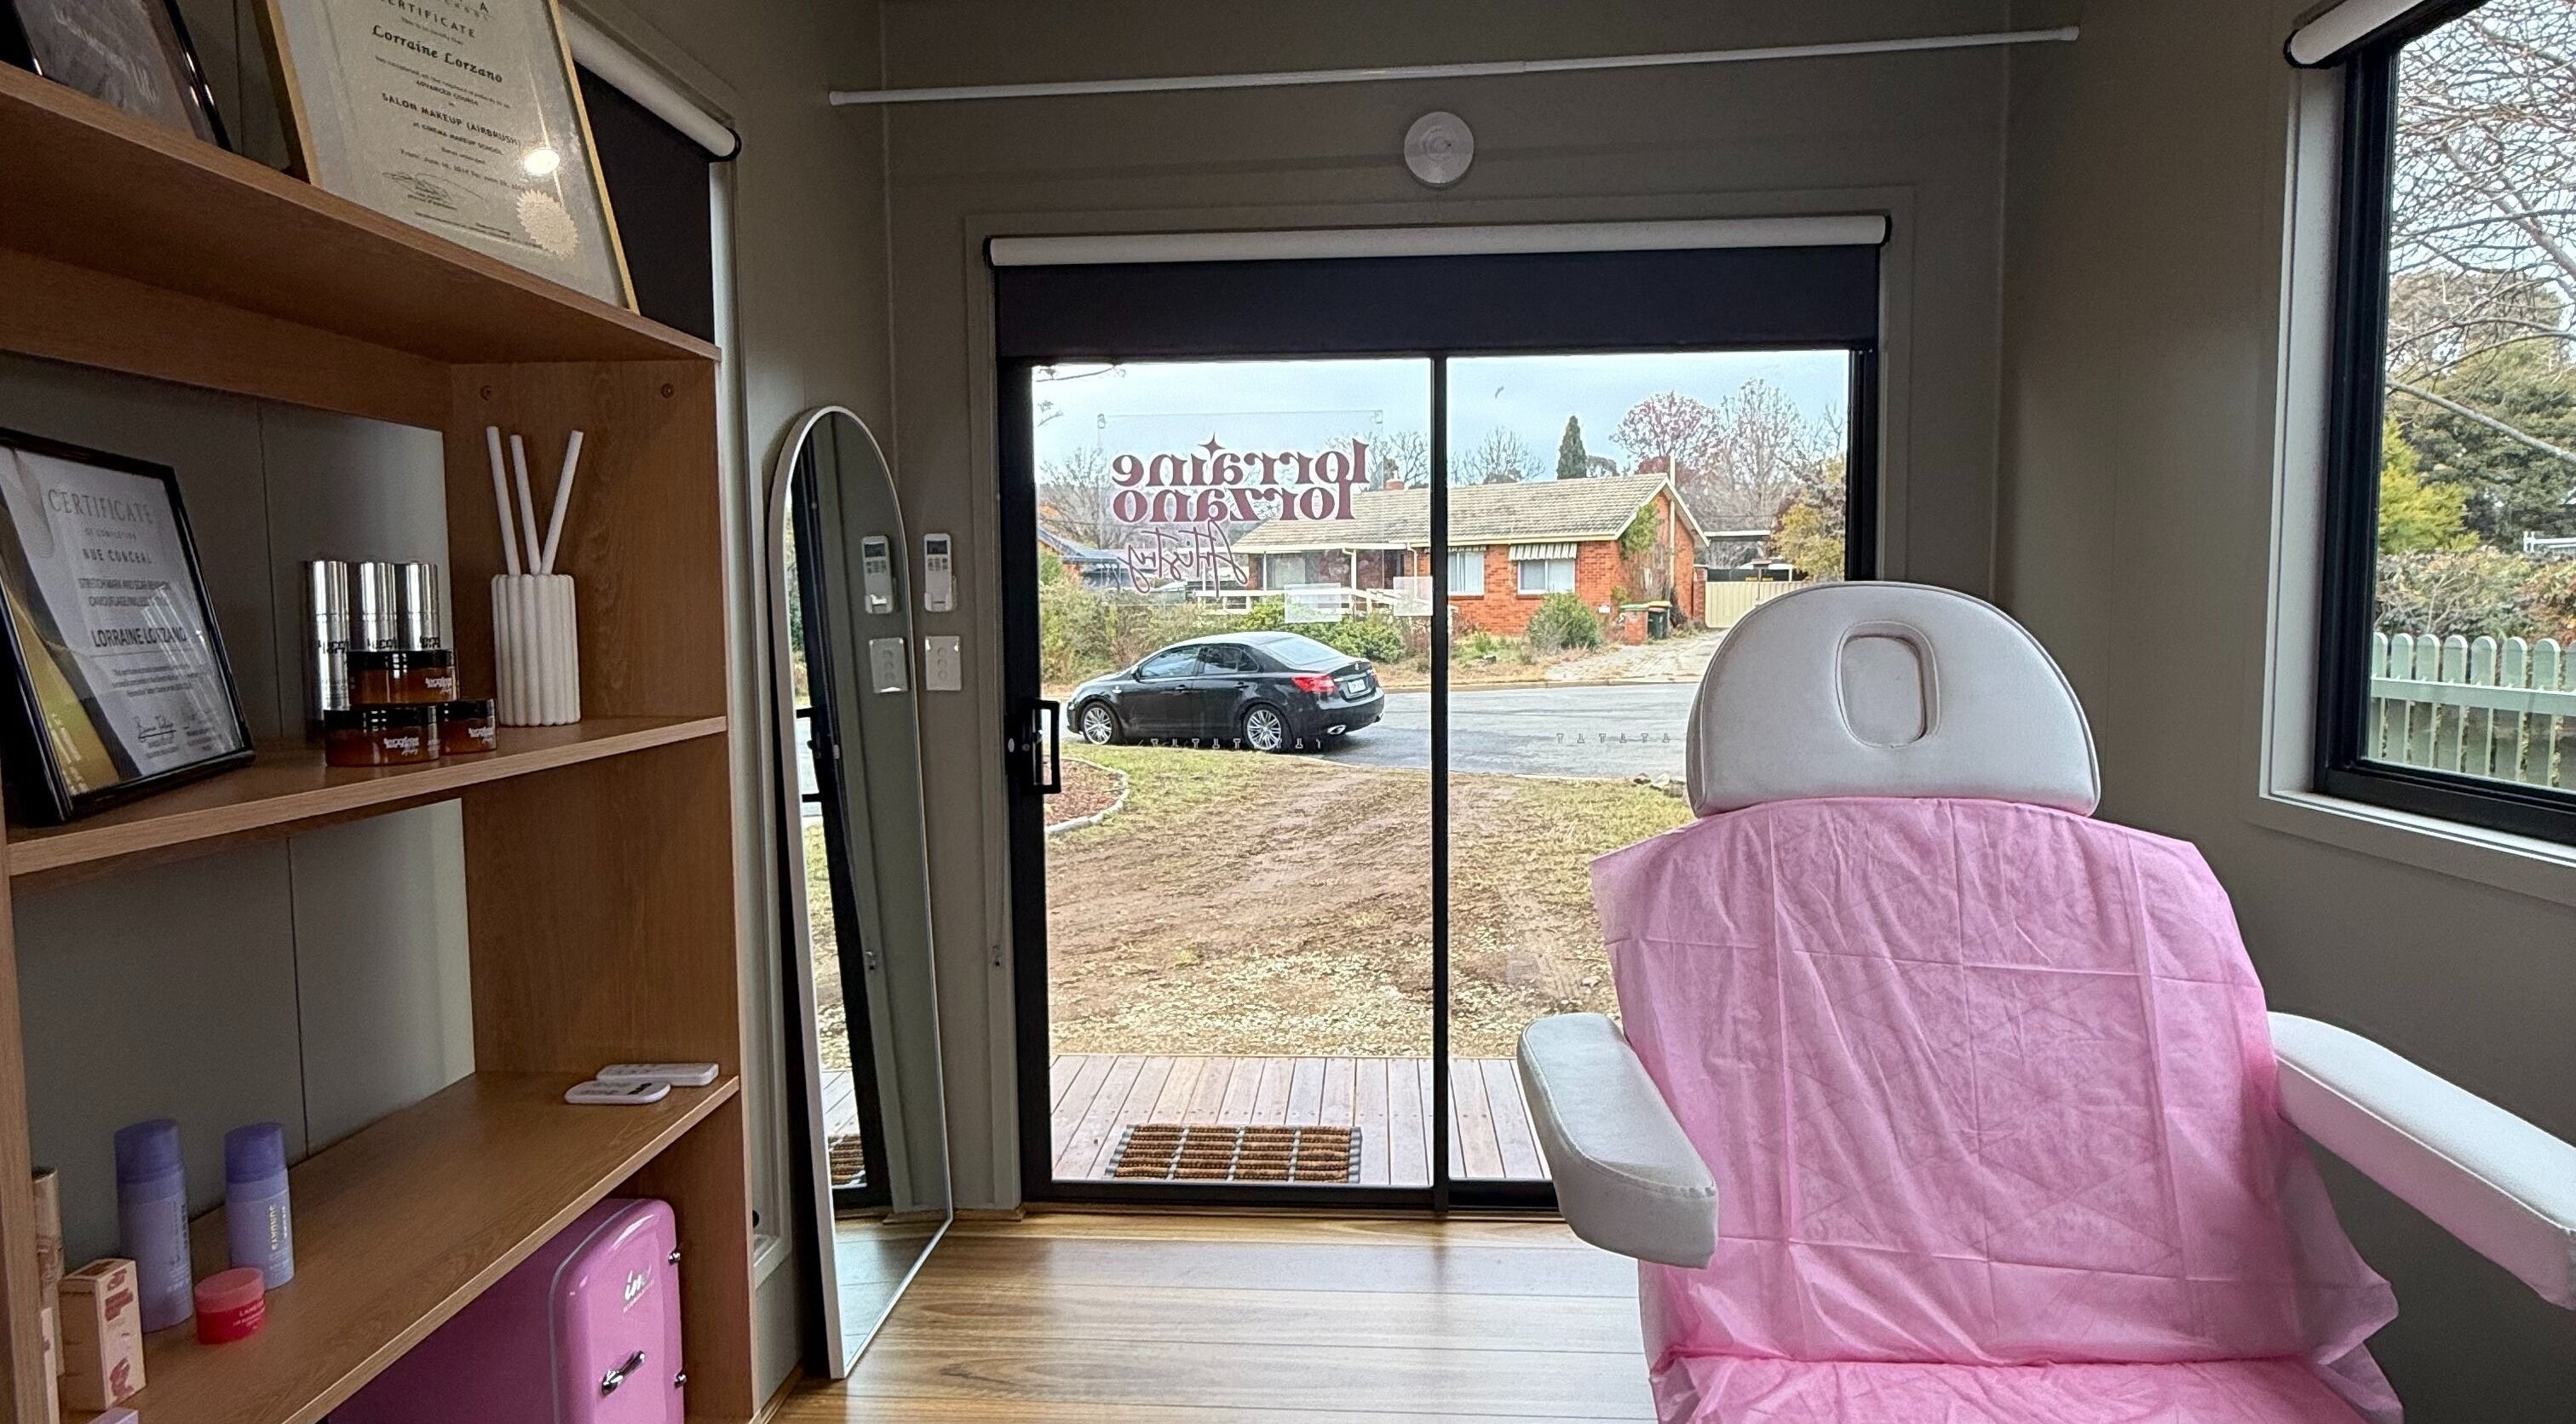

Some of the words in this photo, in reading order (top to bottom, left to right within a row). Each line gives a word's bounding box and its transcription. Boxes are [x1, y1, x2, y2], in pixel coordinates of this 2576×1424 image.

[380, 0, 475, 38] ERTIFICATE
[371, 24, 439, 59] Lorraine
[444, 53, 503, 83] Lorzano
[382, 92, 417, 112] SALON
[421, 106, 463, 126] MAKEUP
[48, 489, 153, 525] CERTIFICATE
[107, 549, 152, 564] CONCEAL
[91, 627, 144, 647] LORRAINE
